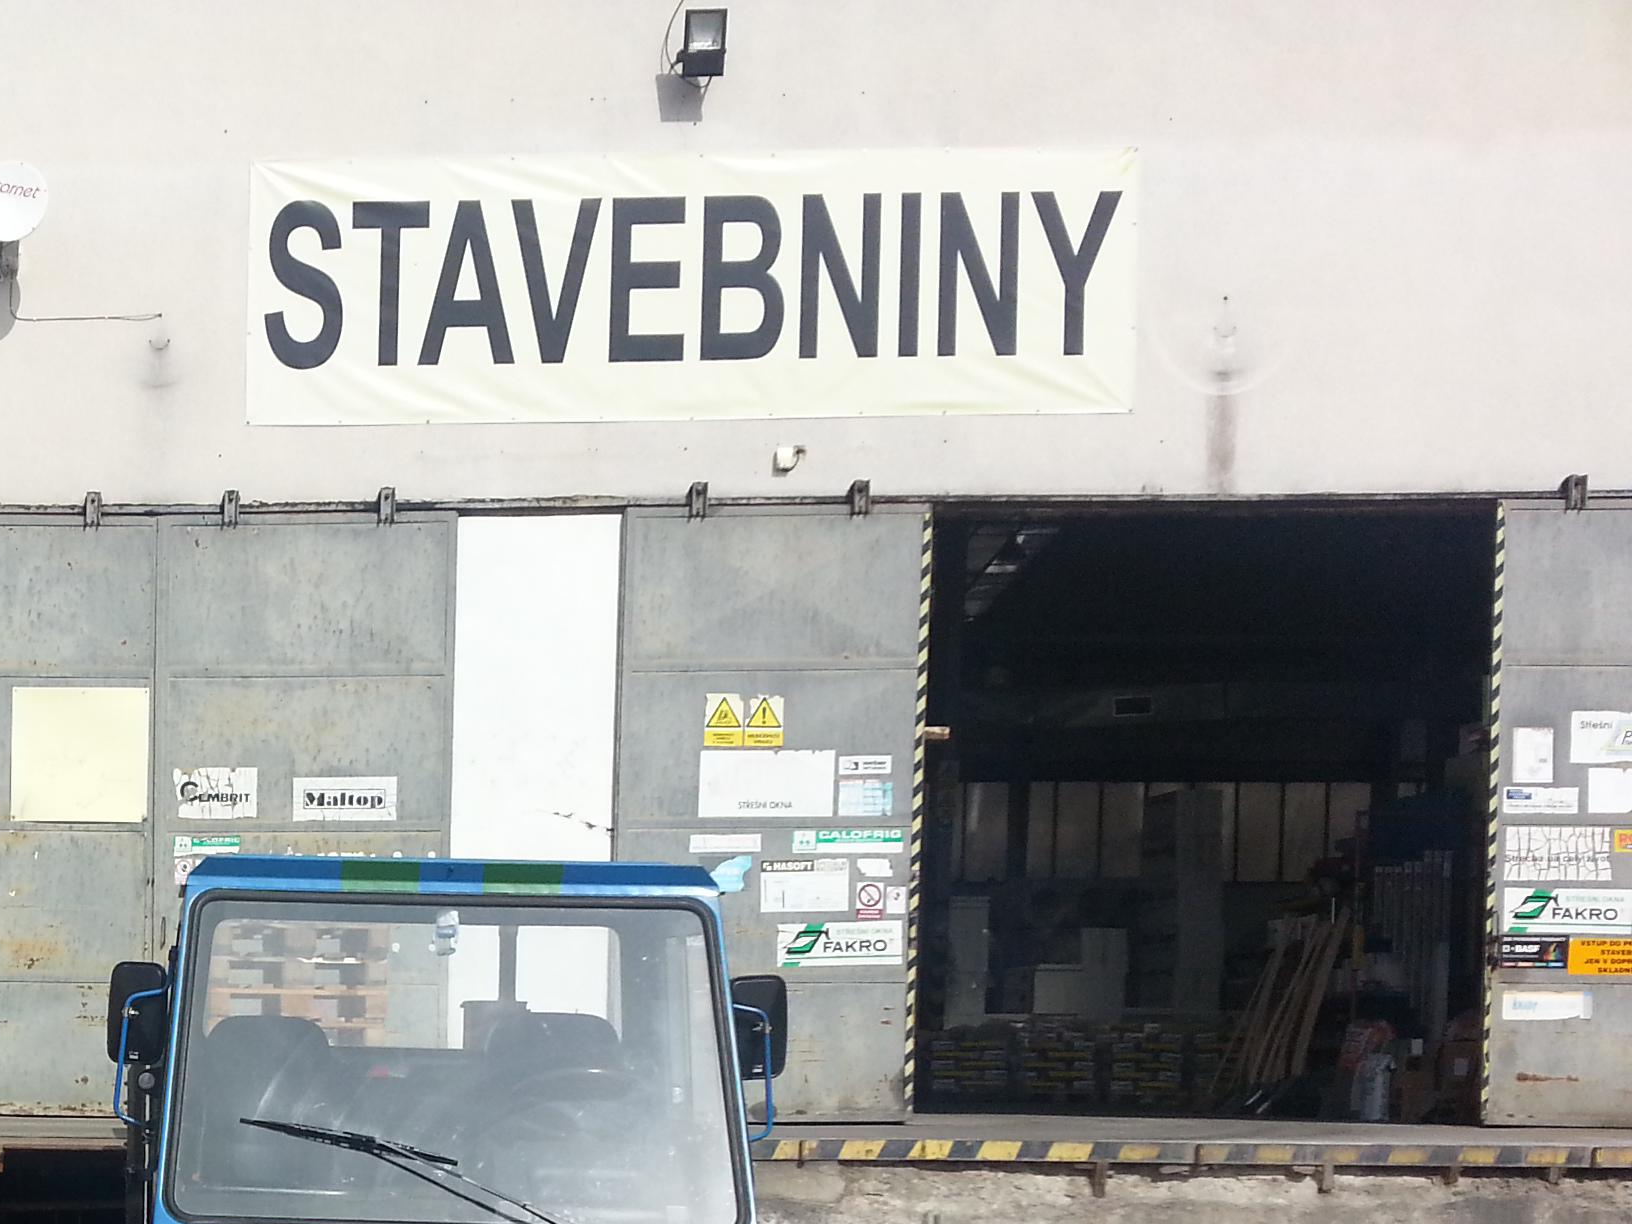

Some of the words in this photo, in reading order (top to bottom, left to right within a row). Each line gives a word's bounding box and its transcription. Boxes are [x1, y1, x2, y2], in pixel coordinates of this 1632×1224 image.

[264, 189, 1123, 370] STAVEBNINY
[305, 792, 383, 808] Maltop
[818, 830, 902, 839] CALOFRIG
[1552, 907, 1618, 920] FAKRO
[823, 939, 887, 953] FAKRO
[1515, 944, 1541, 953] BASF
